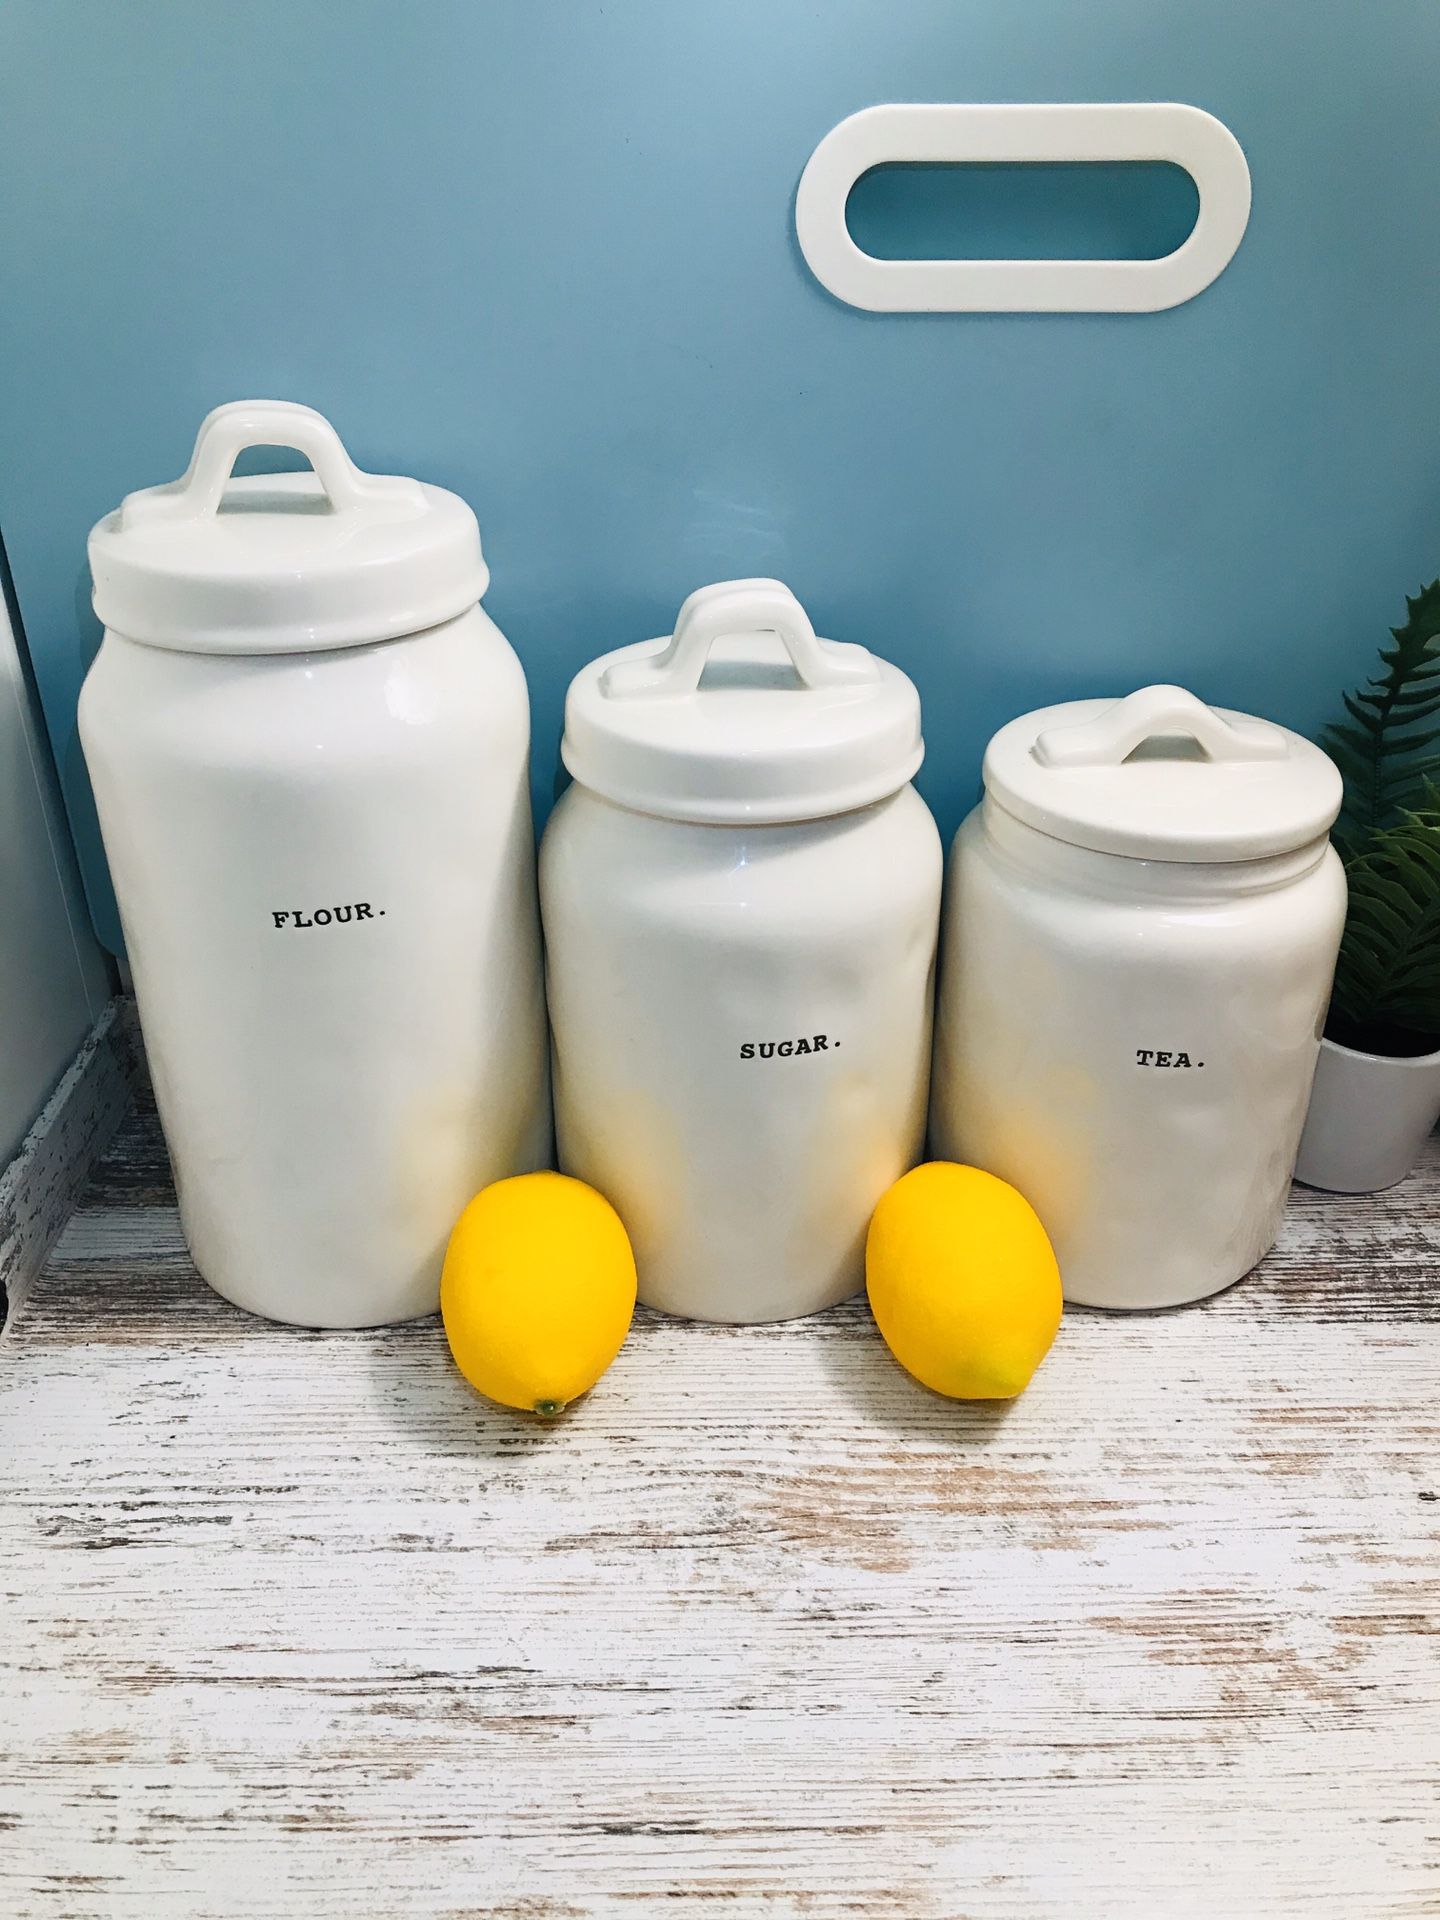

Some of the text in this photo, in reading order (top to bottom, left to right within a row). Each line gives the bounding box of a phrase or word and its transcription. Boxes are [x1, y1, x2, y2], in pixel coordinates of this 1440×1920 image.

[271, 902, 386, 929] FLOUR.
[739, 1034, 842, 1059] SUGAR.
[1136, 1049, 1206, 1068] TEA.
